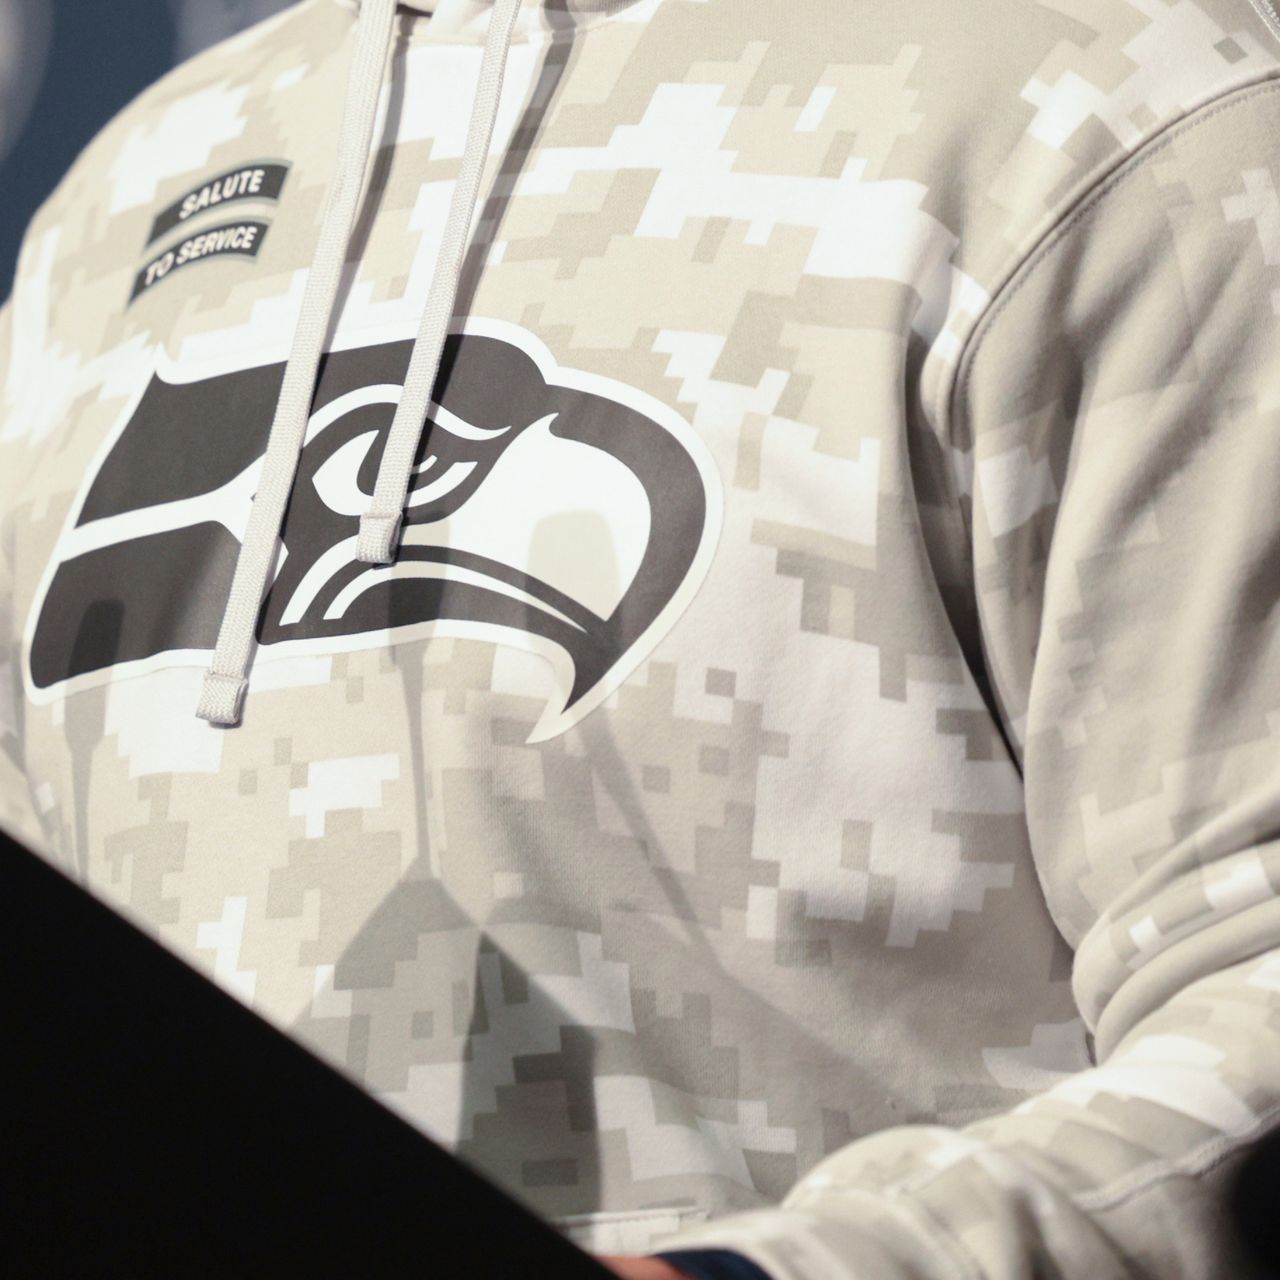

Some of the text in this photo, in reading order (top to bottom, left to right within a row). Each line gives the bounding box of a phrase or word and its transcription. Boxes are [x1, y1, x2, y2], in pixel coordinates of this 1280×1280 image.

[178, 169, 265, 219] SALUTE
[145, 226, 257, 286] TO SERVICE
